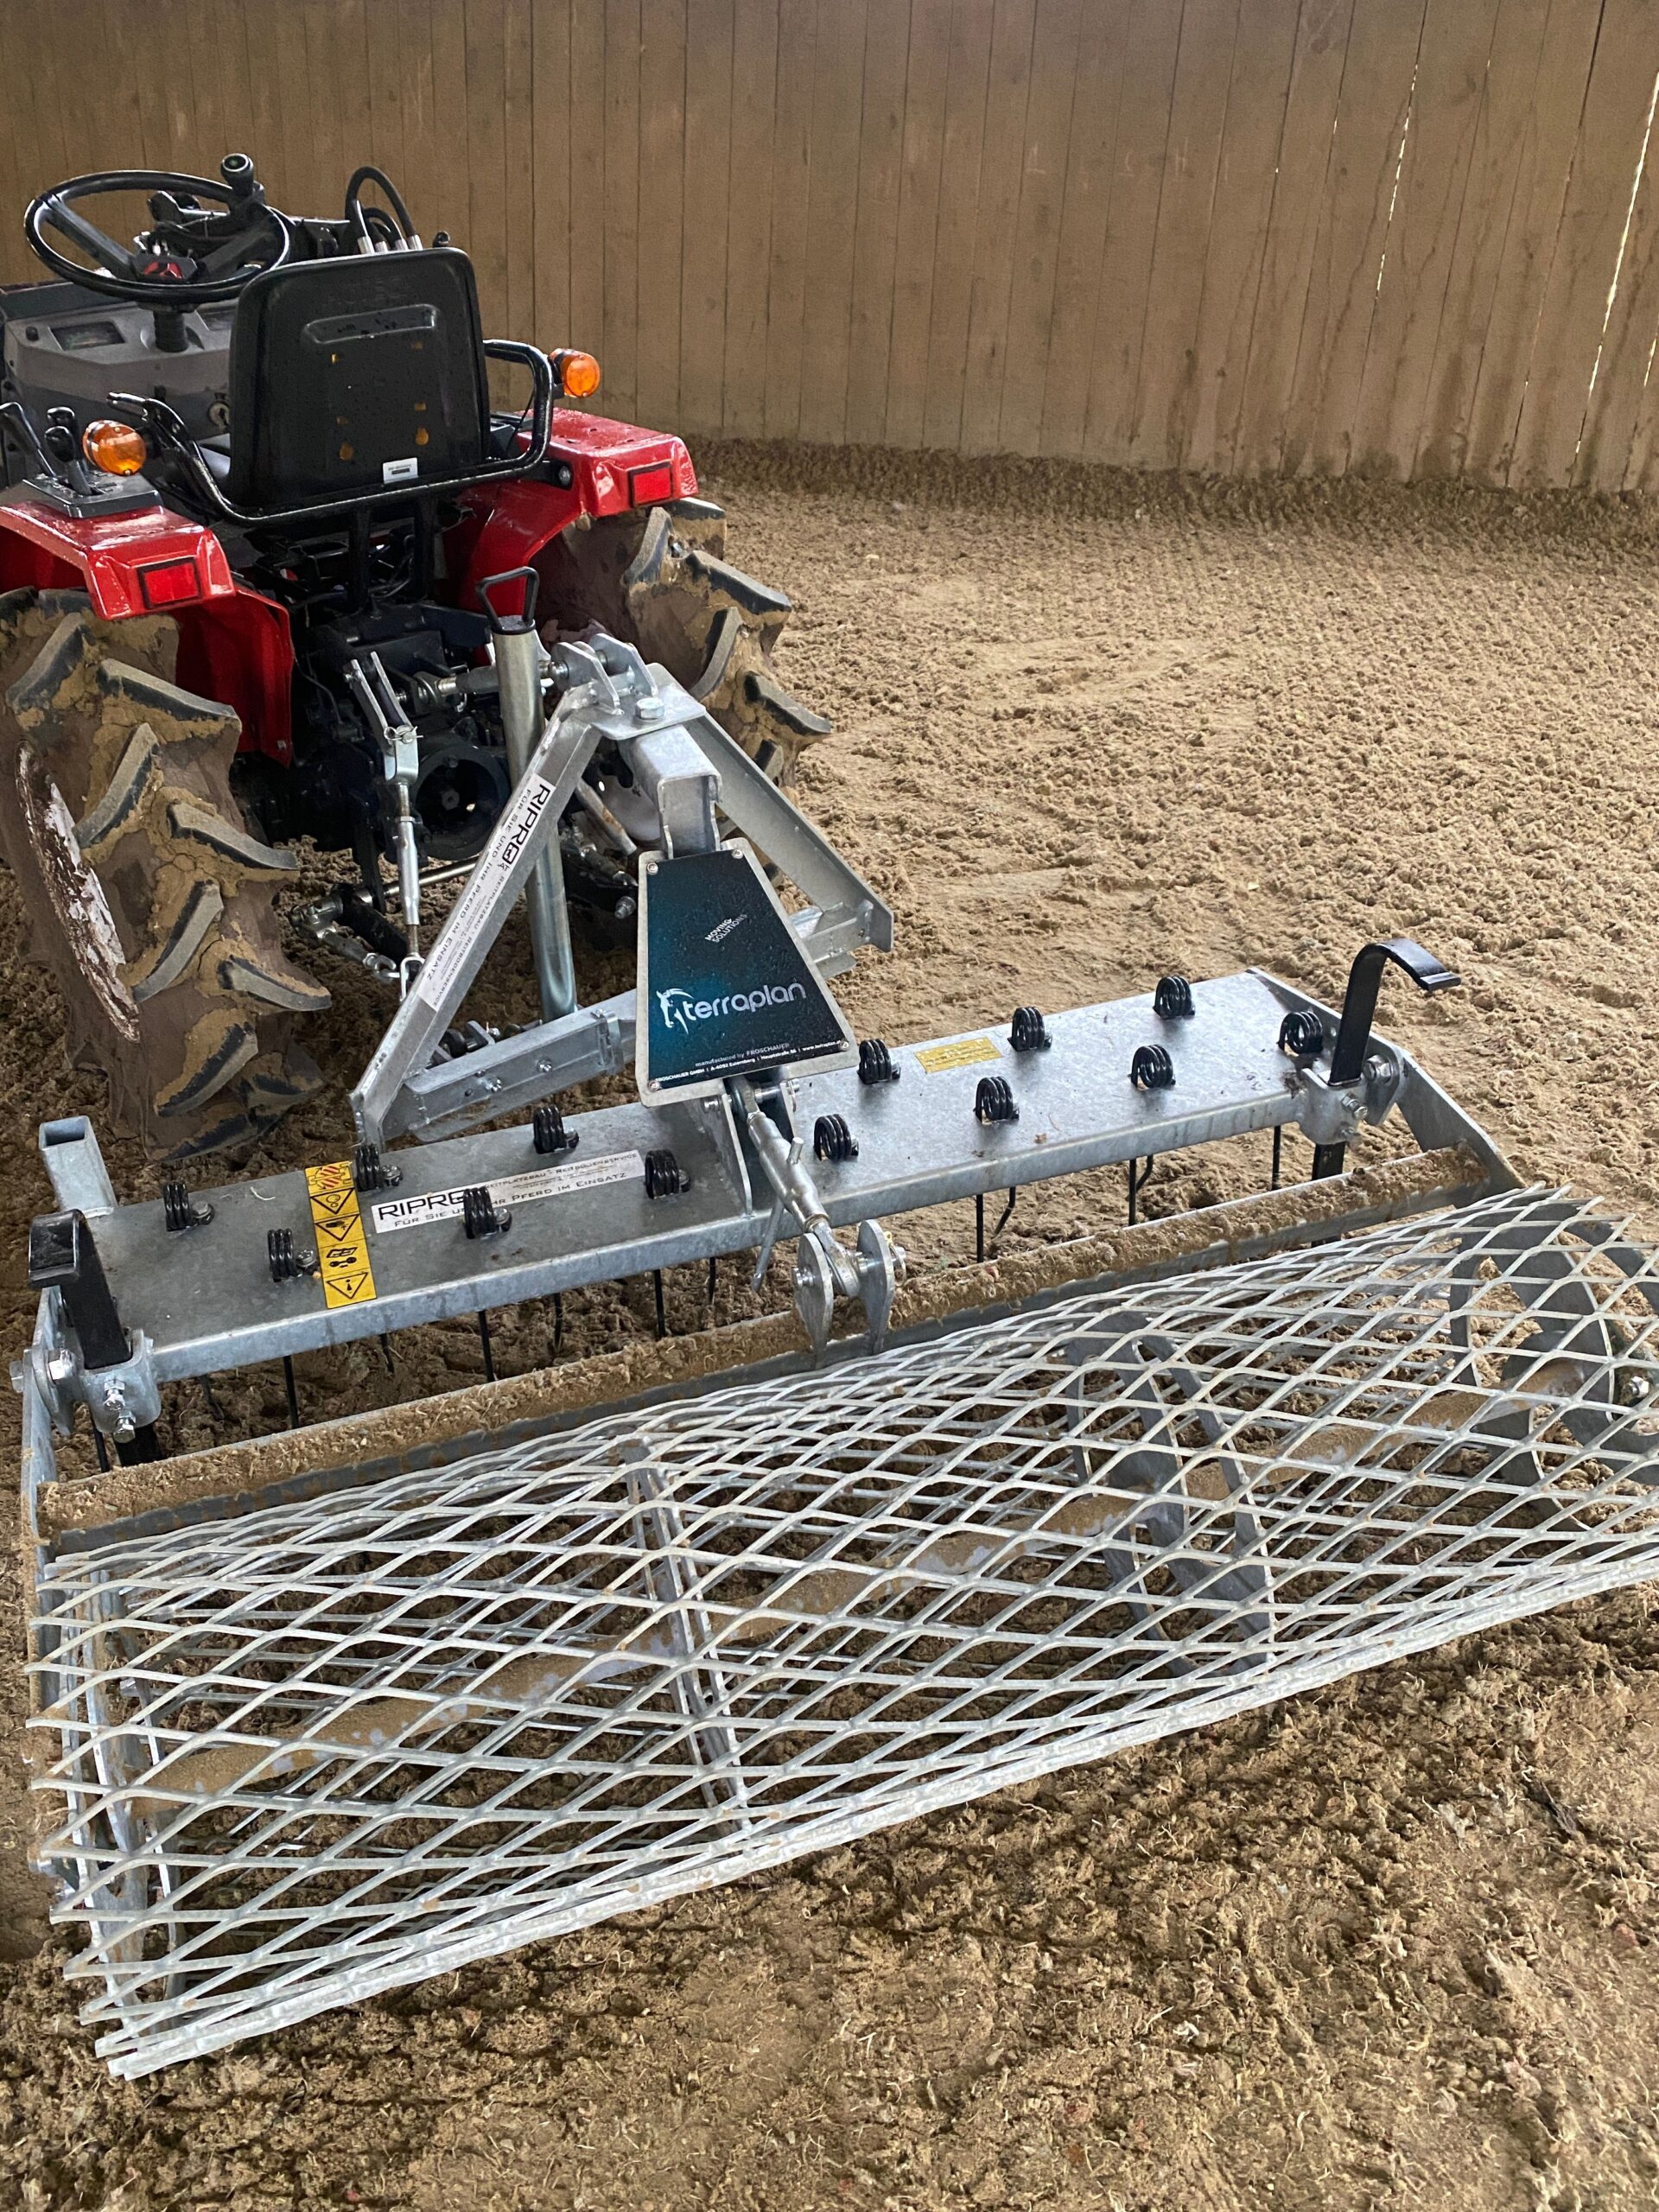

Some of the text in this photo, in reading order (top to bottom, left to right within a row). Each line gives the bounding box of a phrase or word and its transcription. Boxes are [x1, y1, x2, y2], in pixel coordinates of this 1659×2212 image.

[704, 918, 732, 940] MOVING
[712, 914, 747, 943] SOLUTIONS
[682, 982, 807, 1020] terraplan
[695, 1054, 736, 1067] manufactured
[746, 1042, 790, 1056] FROSCHAUER
[575, 1172, 626, 1187] EINSATZ
